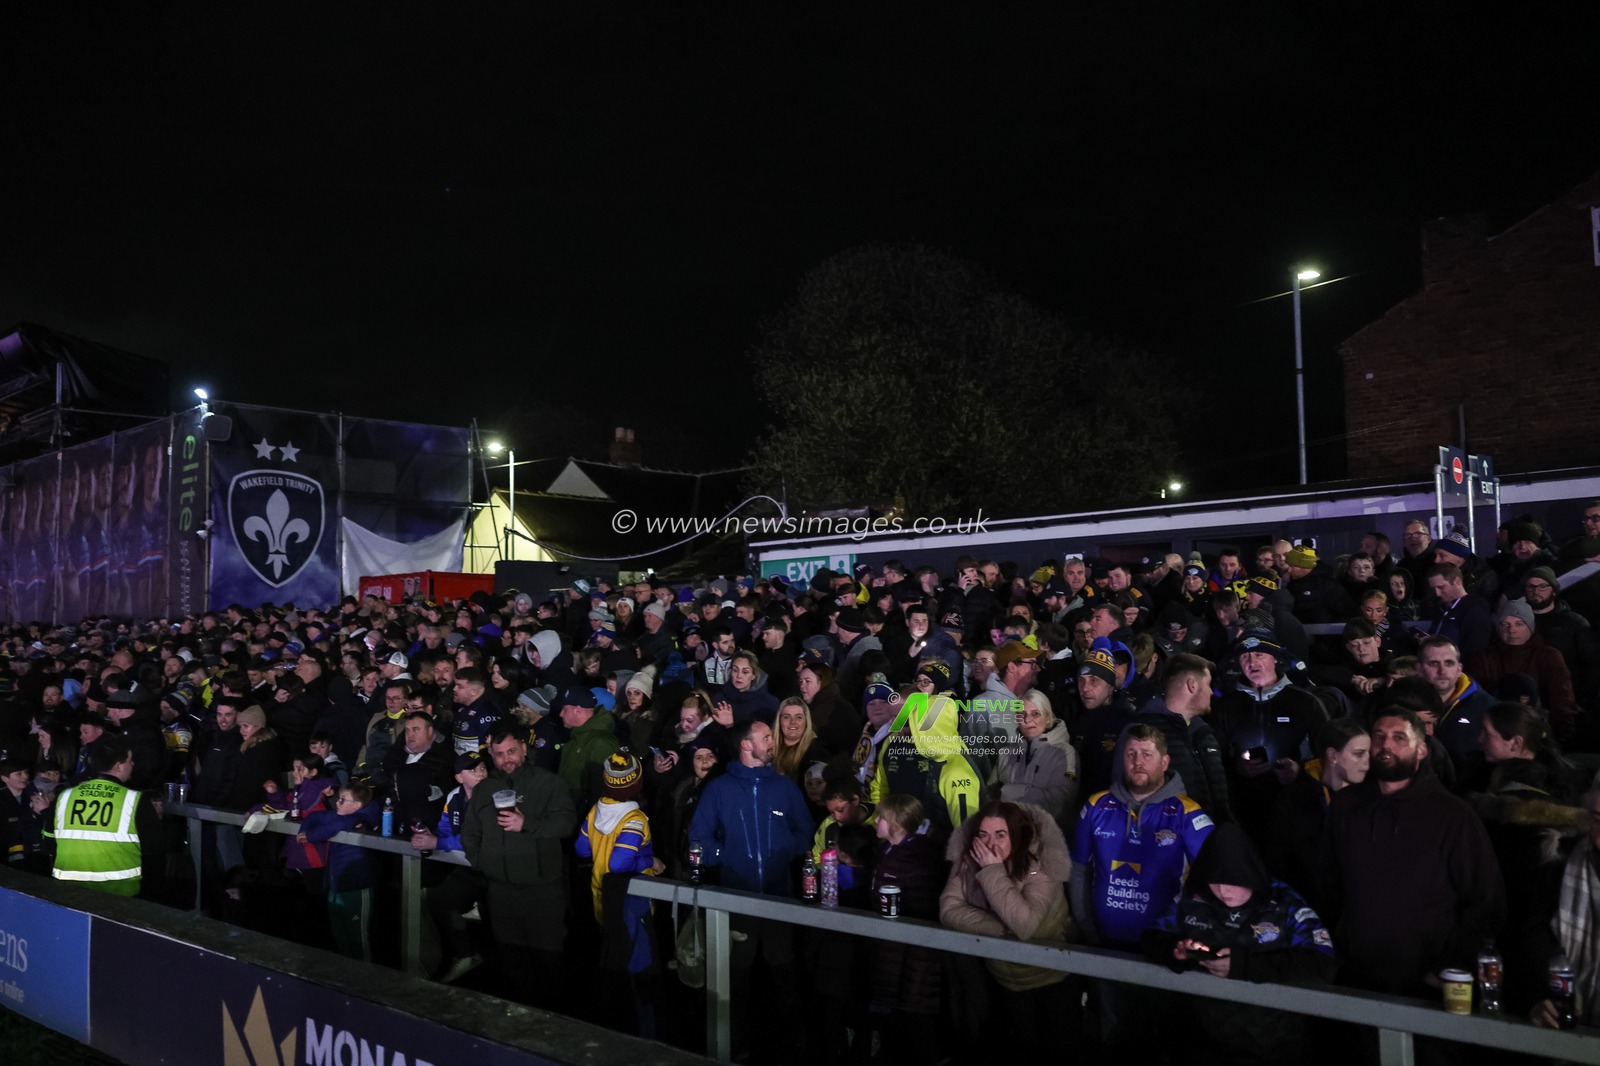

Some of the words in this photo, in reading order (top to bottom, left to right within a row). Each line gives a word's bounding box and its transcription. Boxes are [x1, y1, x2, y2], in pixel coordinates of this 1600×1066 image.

[179, 435, 199, 532] elite
[238, 476, 284, 490] WAKEFIELD
[285, 478, 316, 495] TRINITY
[78, 783, 102, 791] BELLE
[104, 784, 121, 793] VUE
[951, 778, 972, 789] AXIS
[79, 790, 115, 799] STADIUM
[70, 799, 114, 827] R20
[1109, 873, 1140, 888] Leeds
[1107, 885, 1150, 902] Building
[1106, 897, 1148, 914] Society
[304, 1016, 436, 1066] MON
